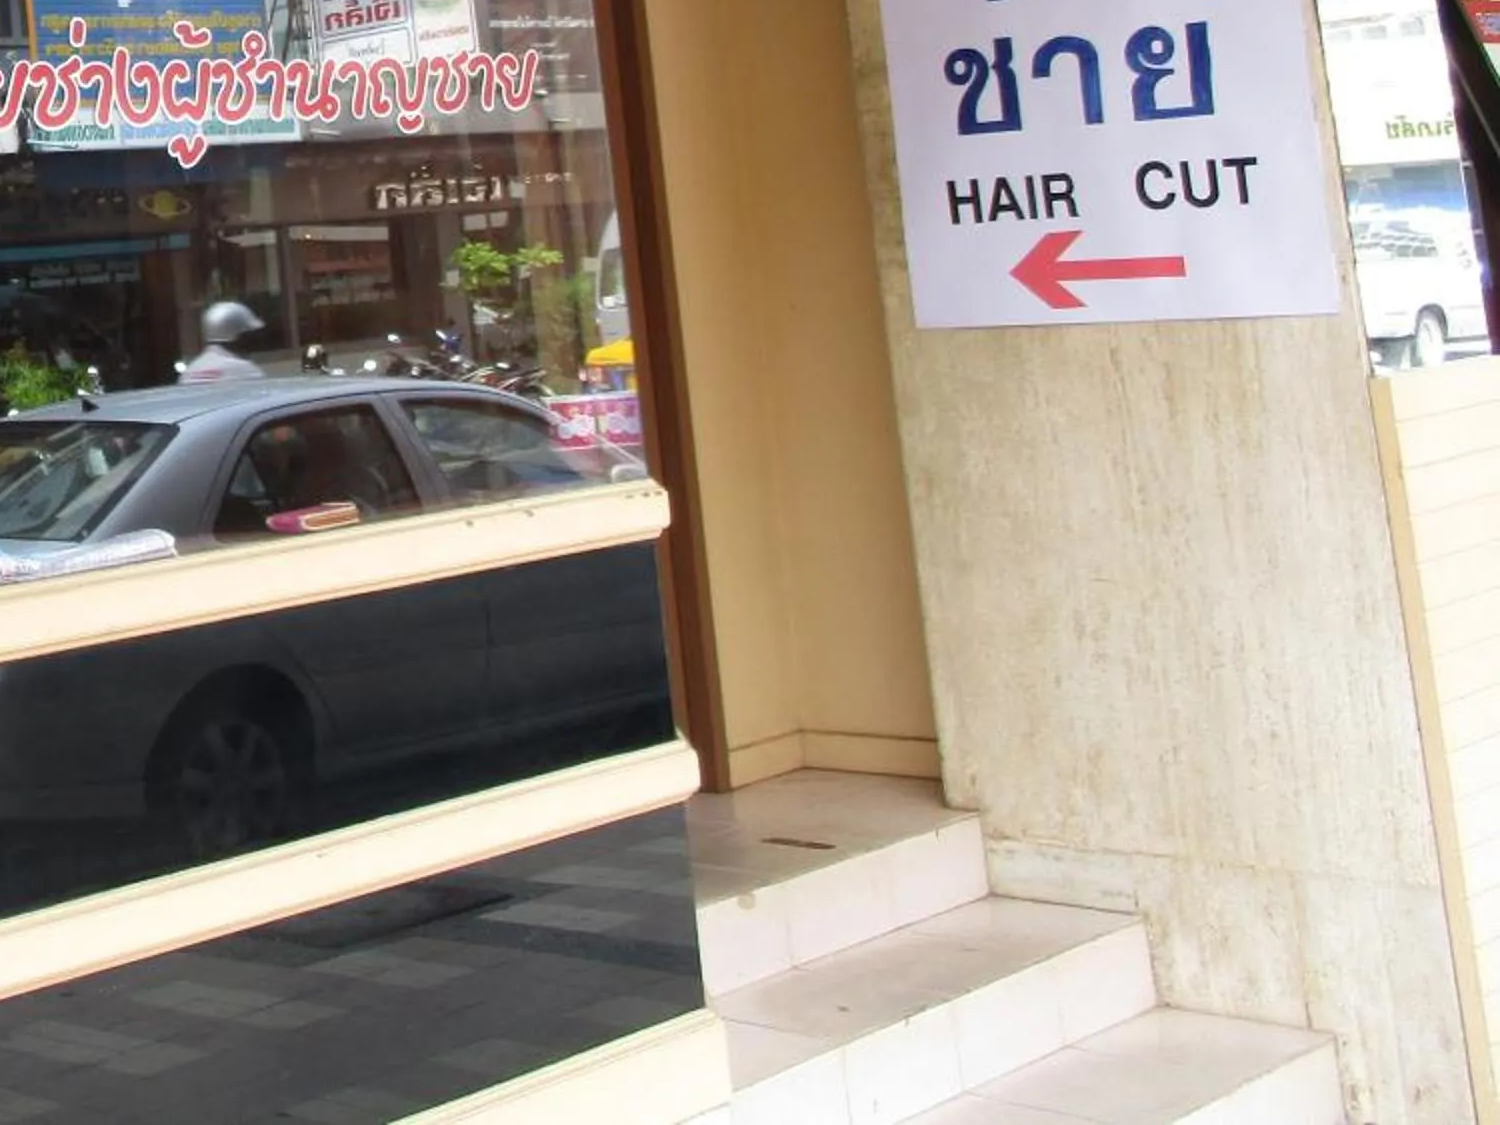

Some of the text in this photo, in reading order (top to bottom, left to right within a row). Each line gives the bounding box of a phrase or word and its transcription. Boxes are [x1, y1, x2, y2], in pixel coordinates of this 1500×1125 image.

[943, 20, 1216, 136] ชาย
[946, 156, 1258, 225] HAIR CUT
